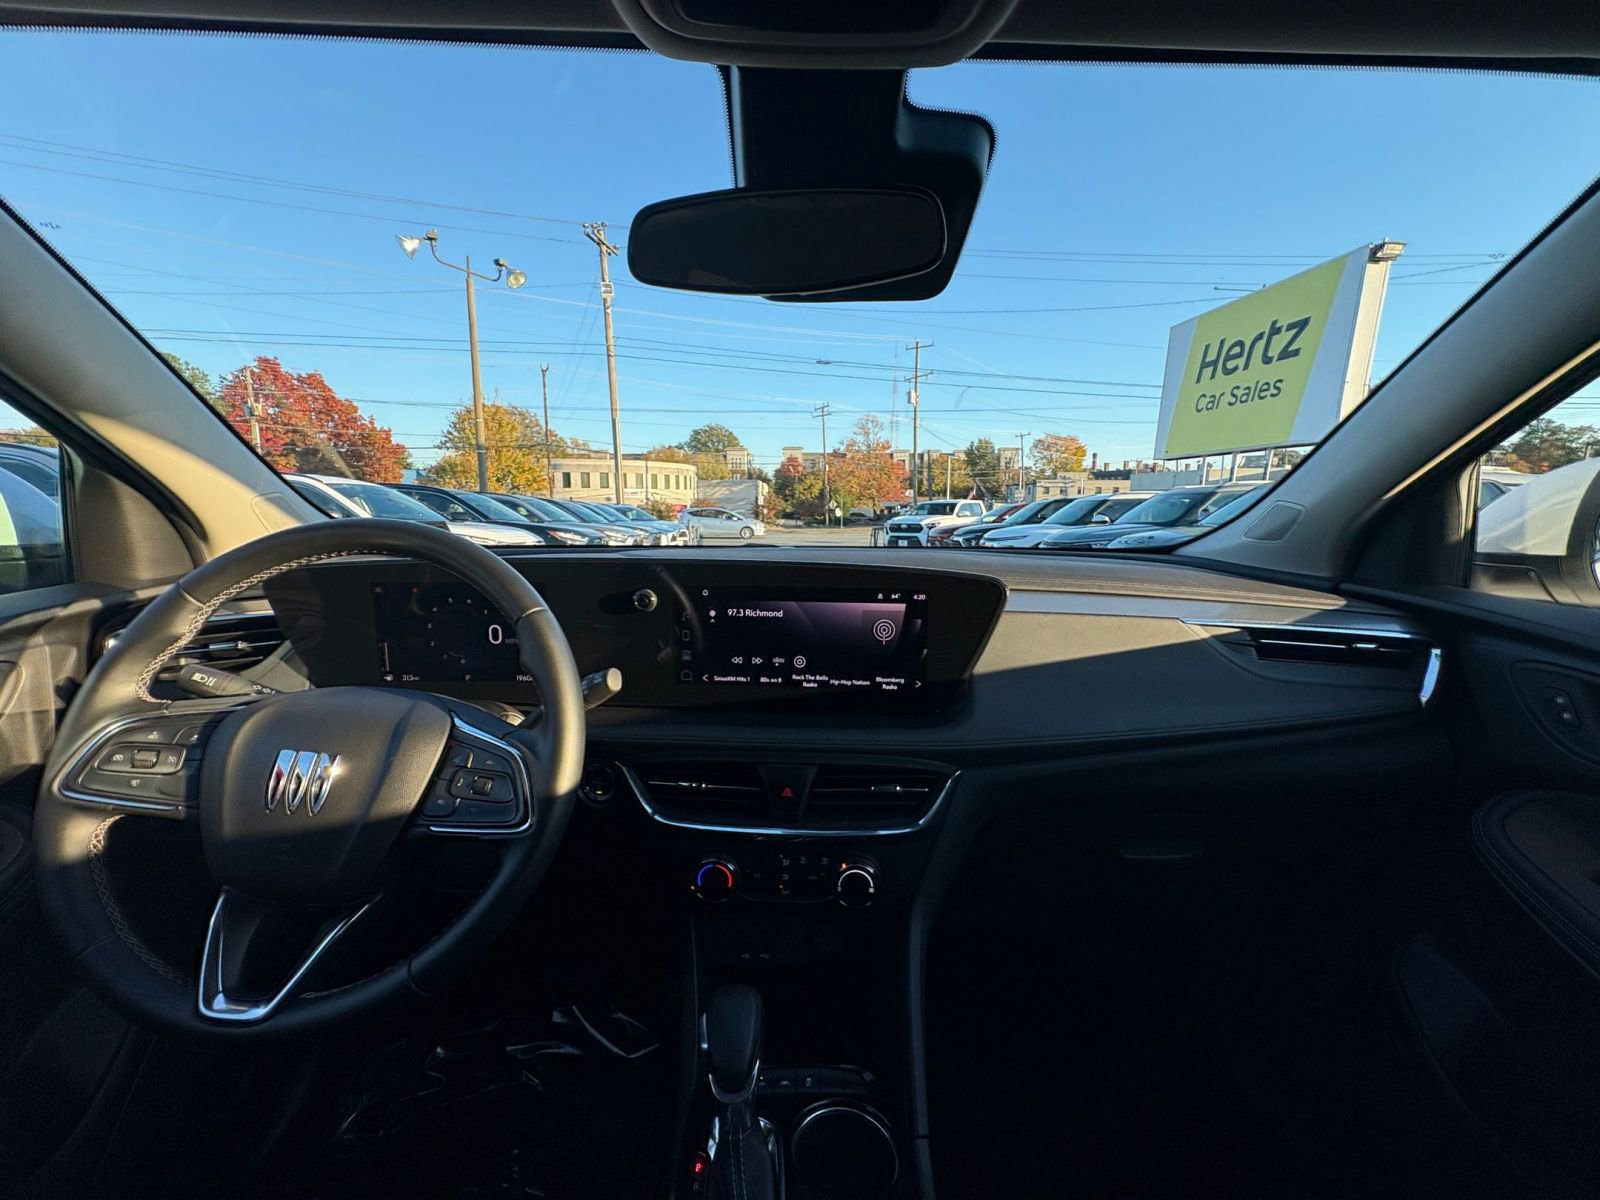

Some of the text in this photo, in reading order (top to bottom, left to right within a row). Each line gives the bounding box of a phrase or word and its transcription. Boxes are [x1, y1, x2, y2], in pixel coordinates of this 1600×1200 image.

[1195, 316, 1311, 384] Hertz
[1195, 378, 1285, 413] Car Sales
[727, 608, 783, 618] 97.3 Richmond
[488, 624, 502, 644] 0
[875, 676, 905, 684] Bloomberg
